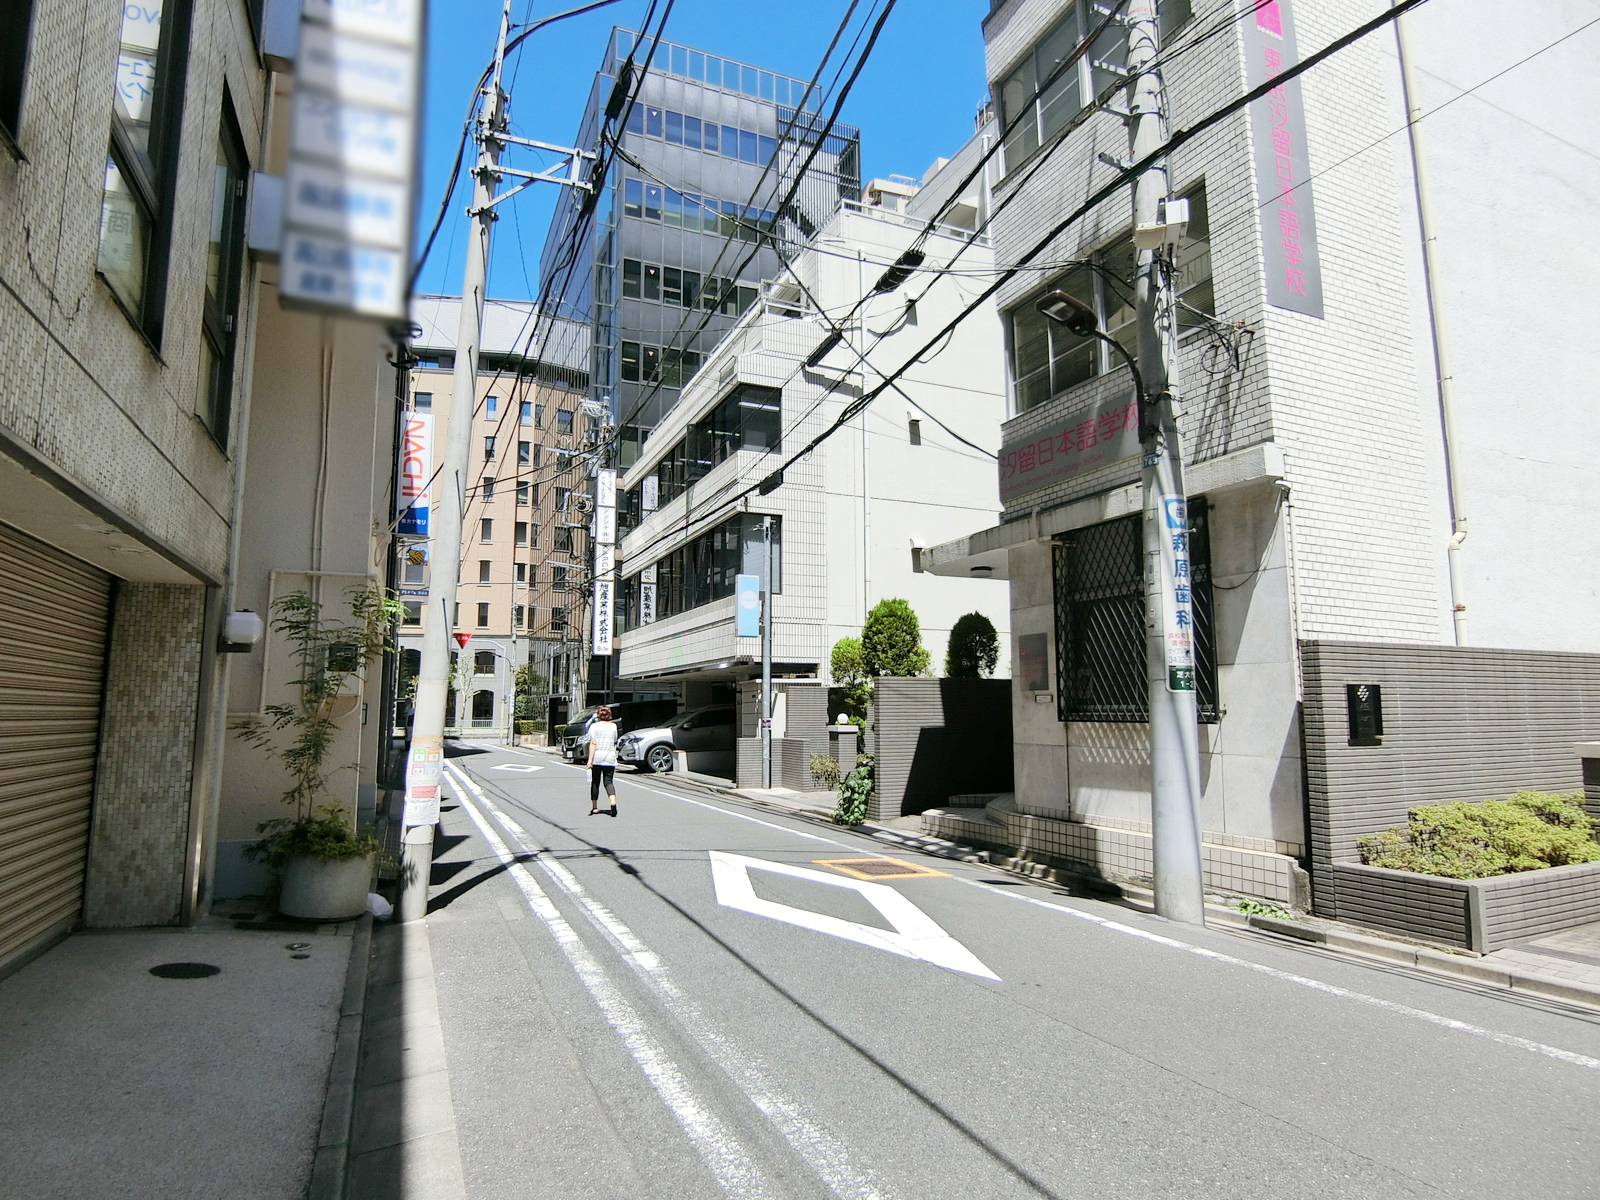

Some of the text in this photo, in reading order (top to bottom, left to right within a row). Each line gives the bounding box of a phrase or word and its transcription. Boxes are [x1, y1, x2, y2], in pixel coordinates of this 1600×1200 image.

[1001, 402, 1138, 480] 汐留日本語学校
